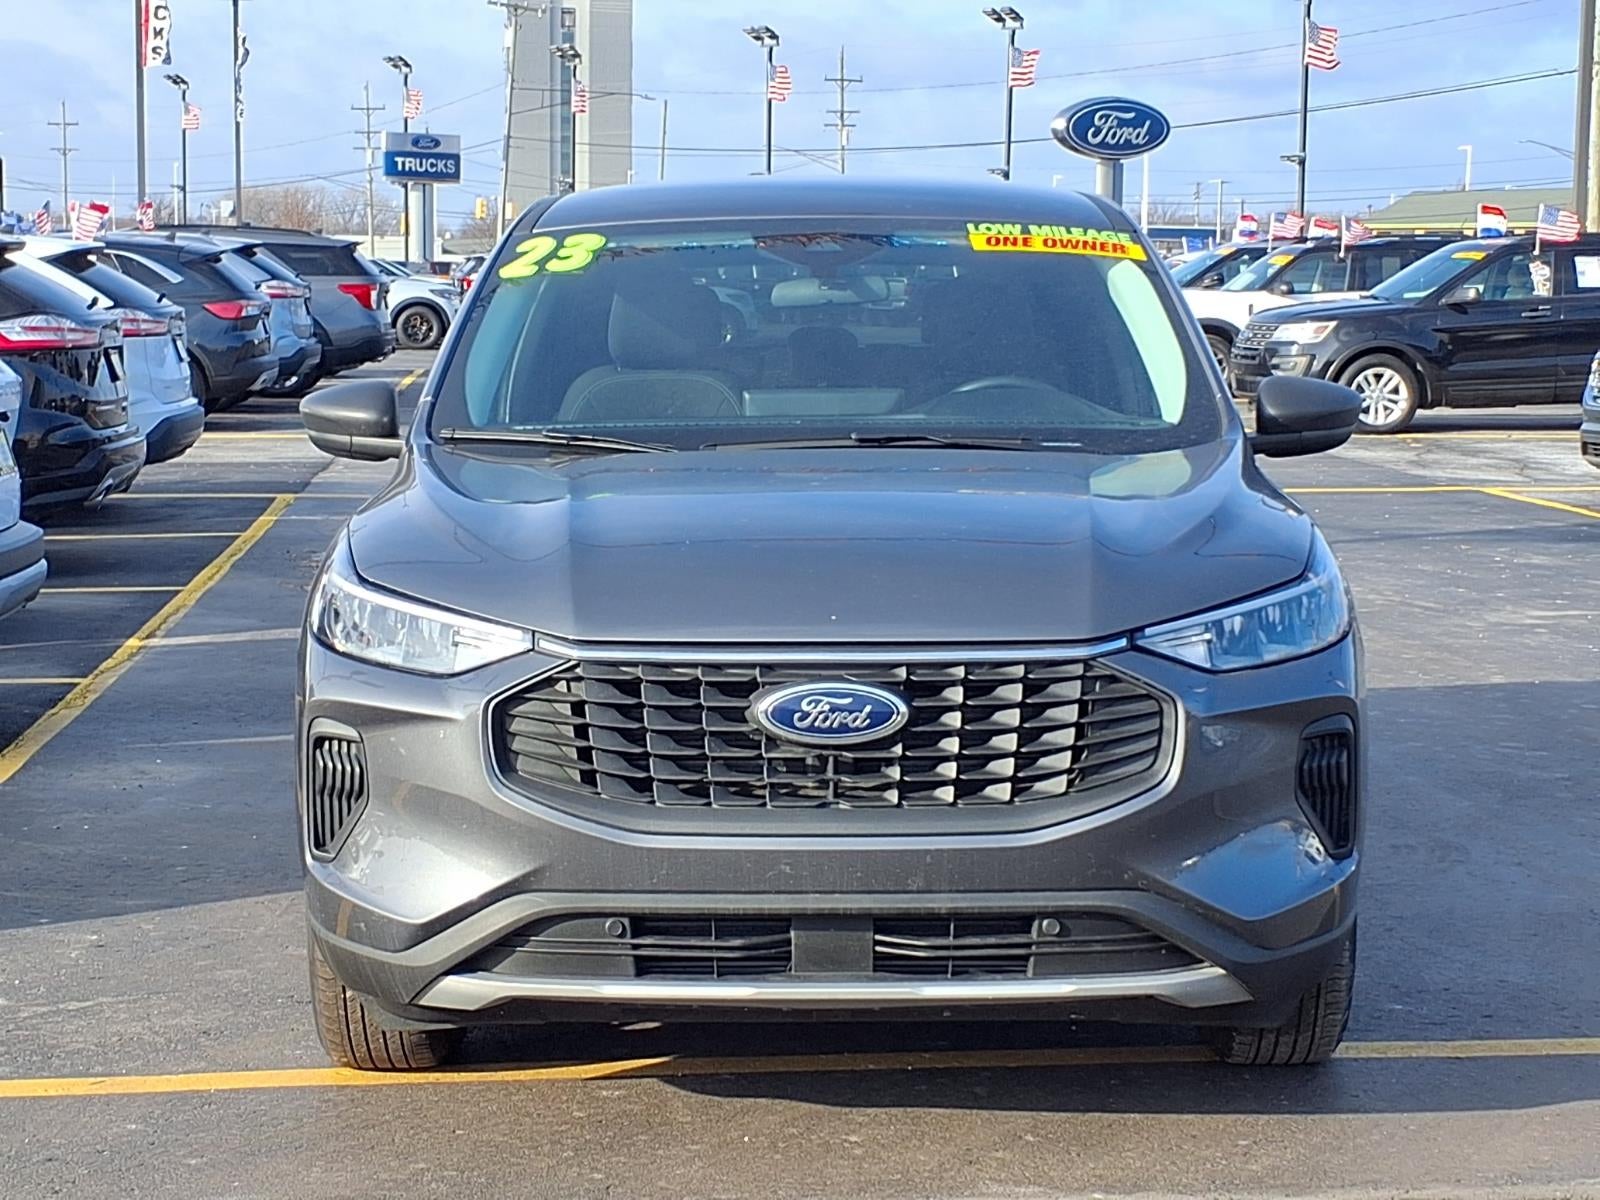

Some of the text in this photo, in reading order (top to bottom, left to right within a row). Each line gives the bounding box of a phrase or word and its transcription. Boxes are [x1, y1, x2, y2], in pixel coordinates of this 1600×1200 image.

[1087, 110, 1151, 144] Ford
[394, 157, 455, 173] TRUCKS
[966, 223, 1132, 242] LOW MILEAGE
[985, 236, 1033, 248] ONE
[498, 233, 607, 279] 23
[793, 695, 872, 728] Ford
